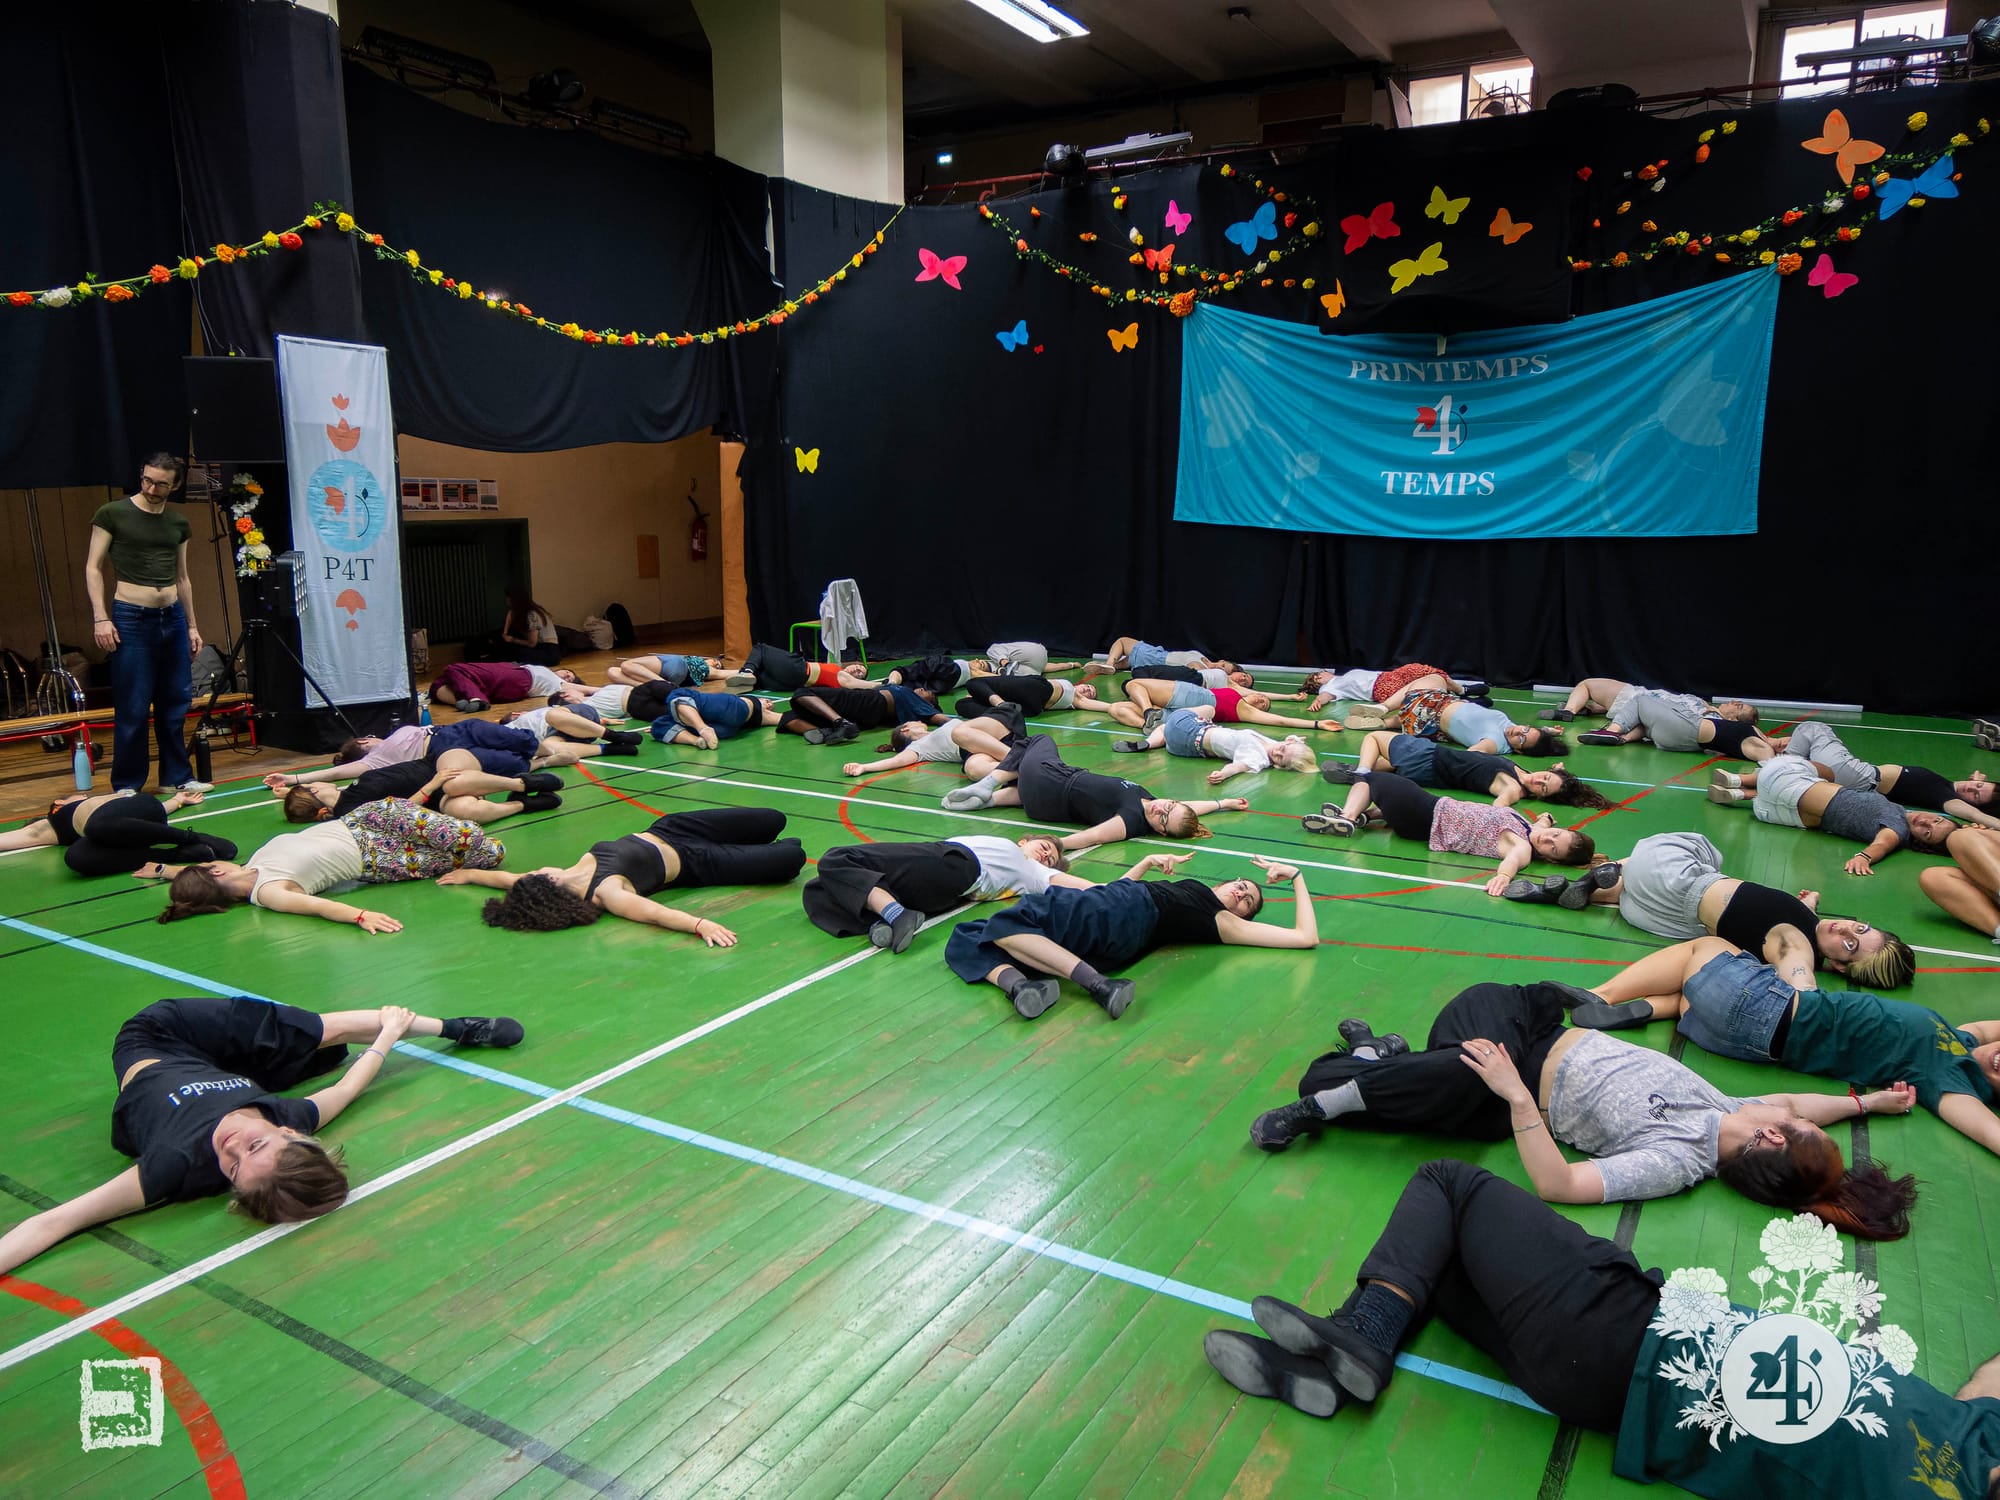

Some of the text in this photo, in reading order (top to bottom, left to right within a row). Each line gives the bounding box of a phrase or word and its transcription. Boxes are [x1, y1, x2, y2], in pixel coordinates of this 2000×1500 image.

[1348, 354, 1549, 382] PRINTEMPS
[1412, 394, 1461, 456] 4
[1380, 471, 1496, 497] TEMPS
[323, 556, 375, 582] P4T
[180, 1077, 252, 1097] Attitude
